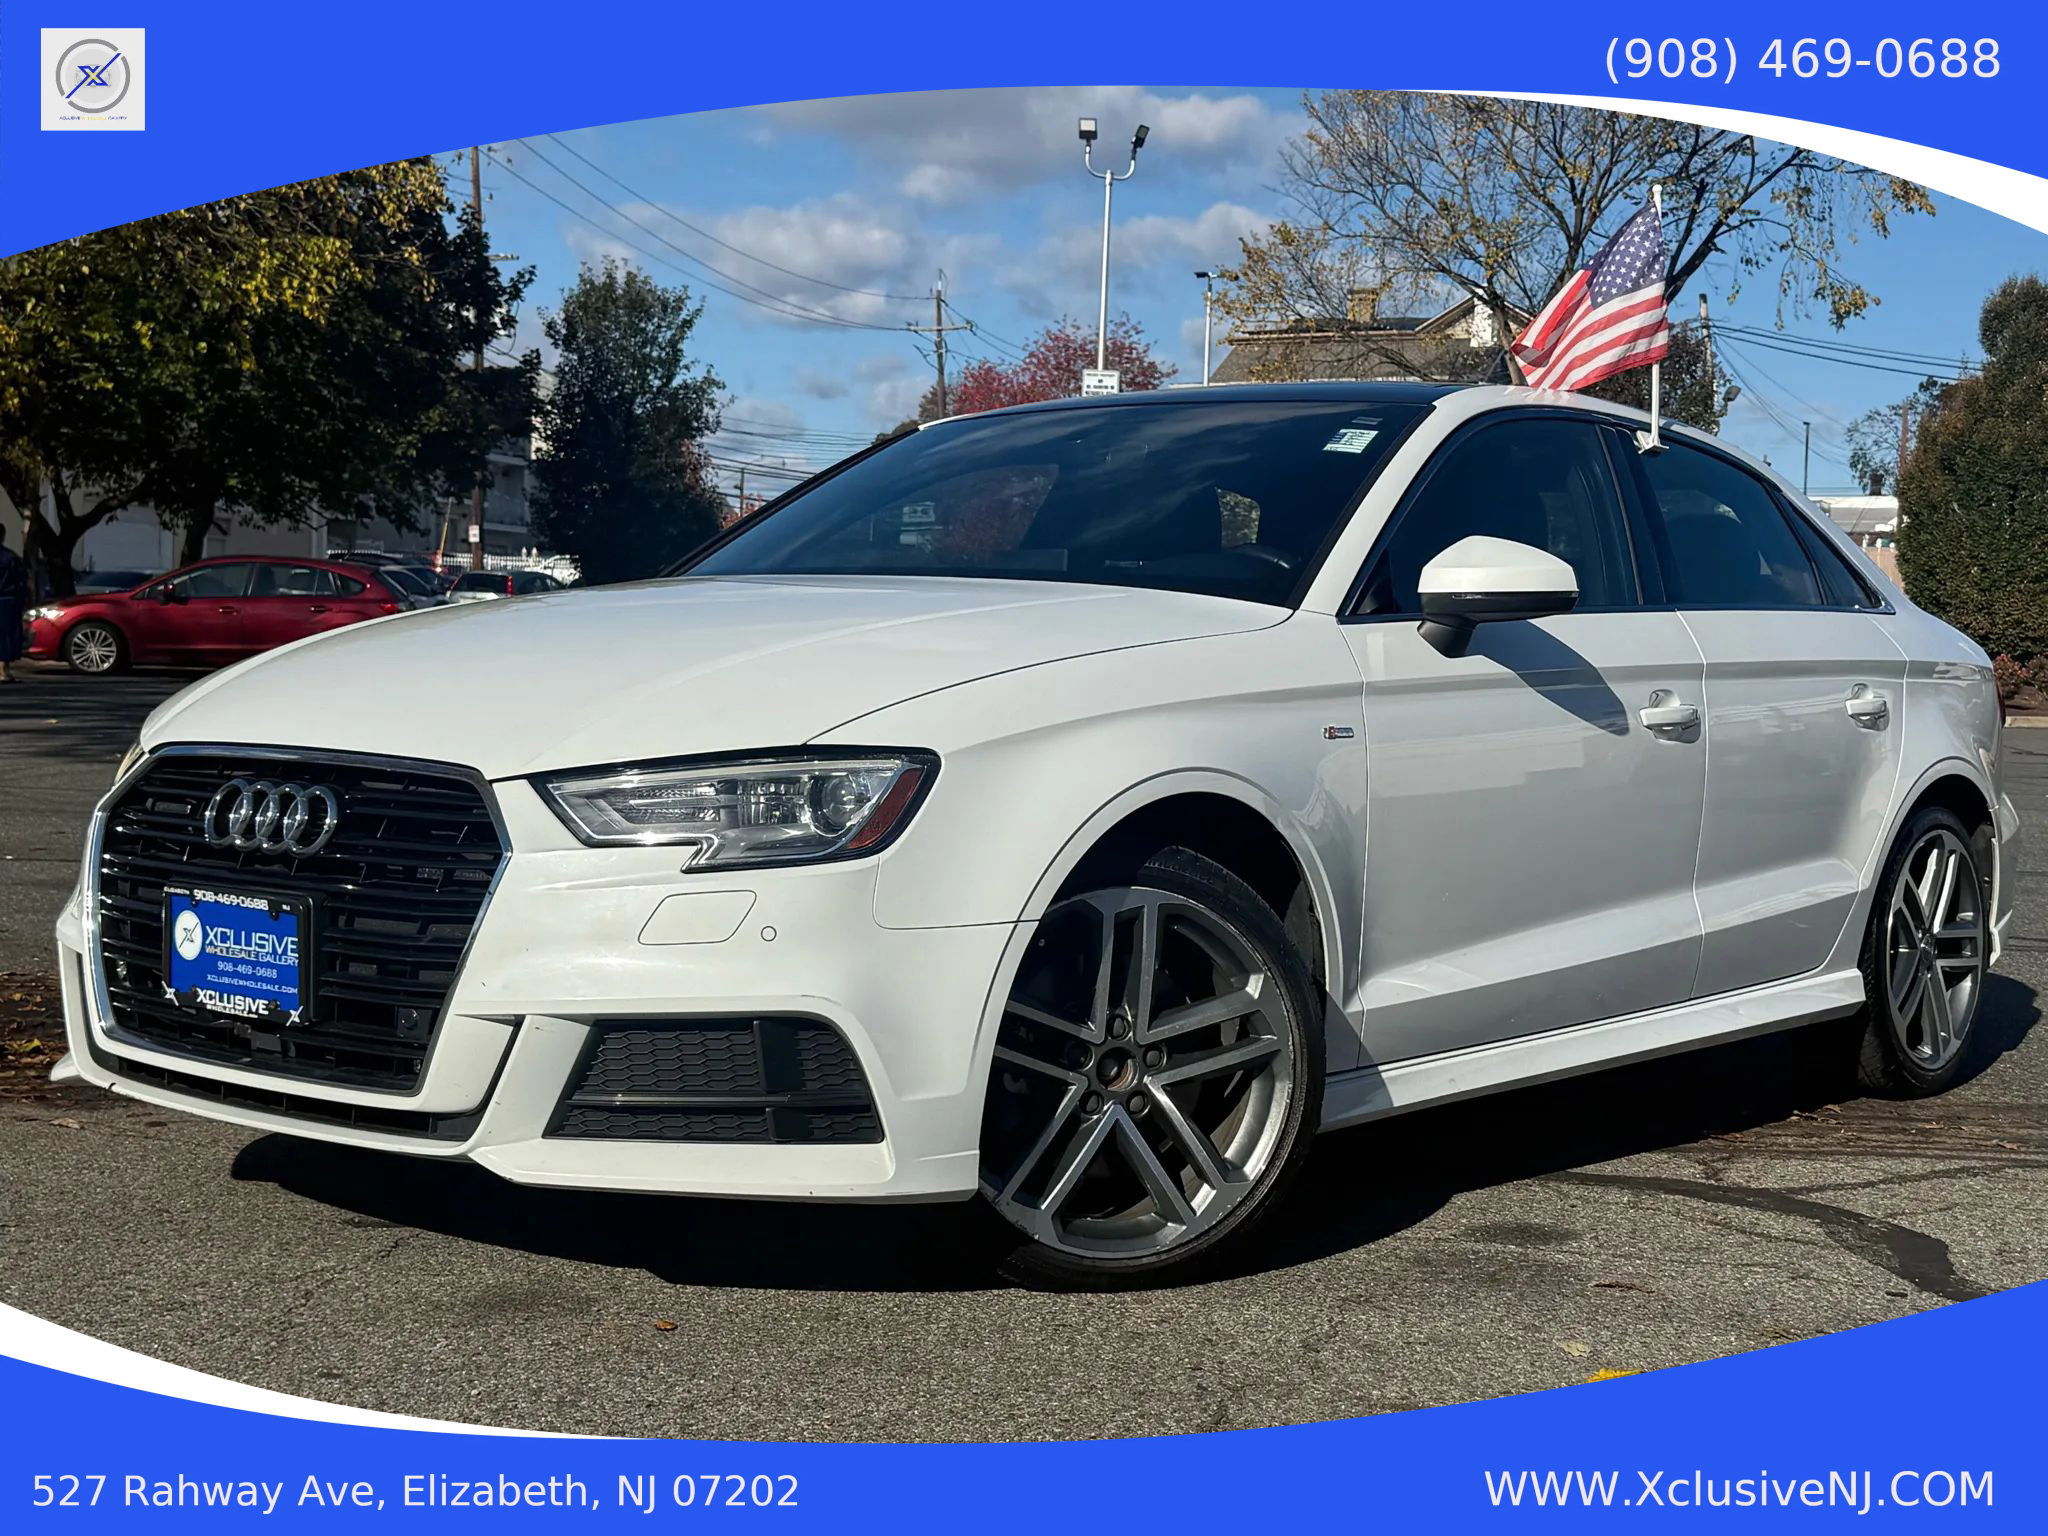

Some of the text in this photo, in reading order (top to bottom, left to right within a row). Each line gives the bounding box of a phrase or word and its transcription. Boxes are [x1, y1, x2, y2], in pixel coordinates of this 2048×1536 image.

[193, 888, 269, 911] 908-469-0688
[205, 925, 299, 957] XCLUSIVE
[205, 945, 299, 967] WHOLESALE GALLERY
[217, 960, 278, 979] 908-469-0688
[206, 974, 298, 994] XCLUSIVEWHOLESALE.COM
[195, 987, 270, 1015] XCLUSIVE
